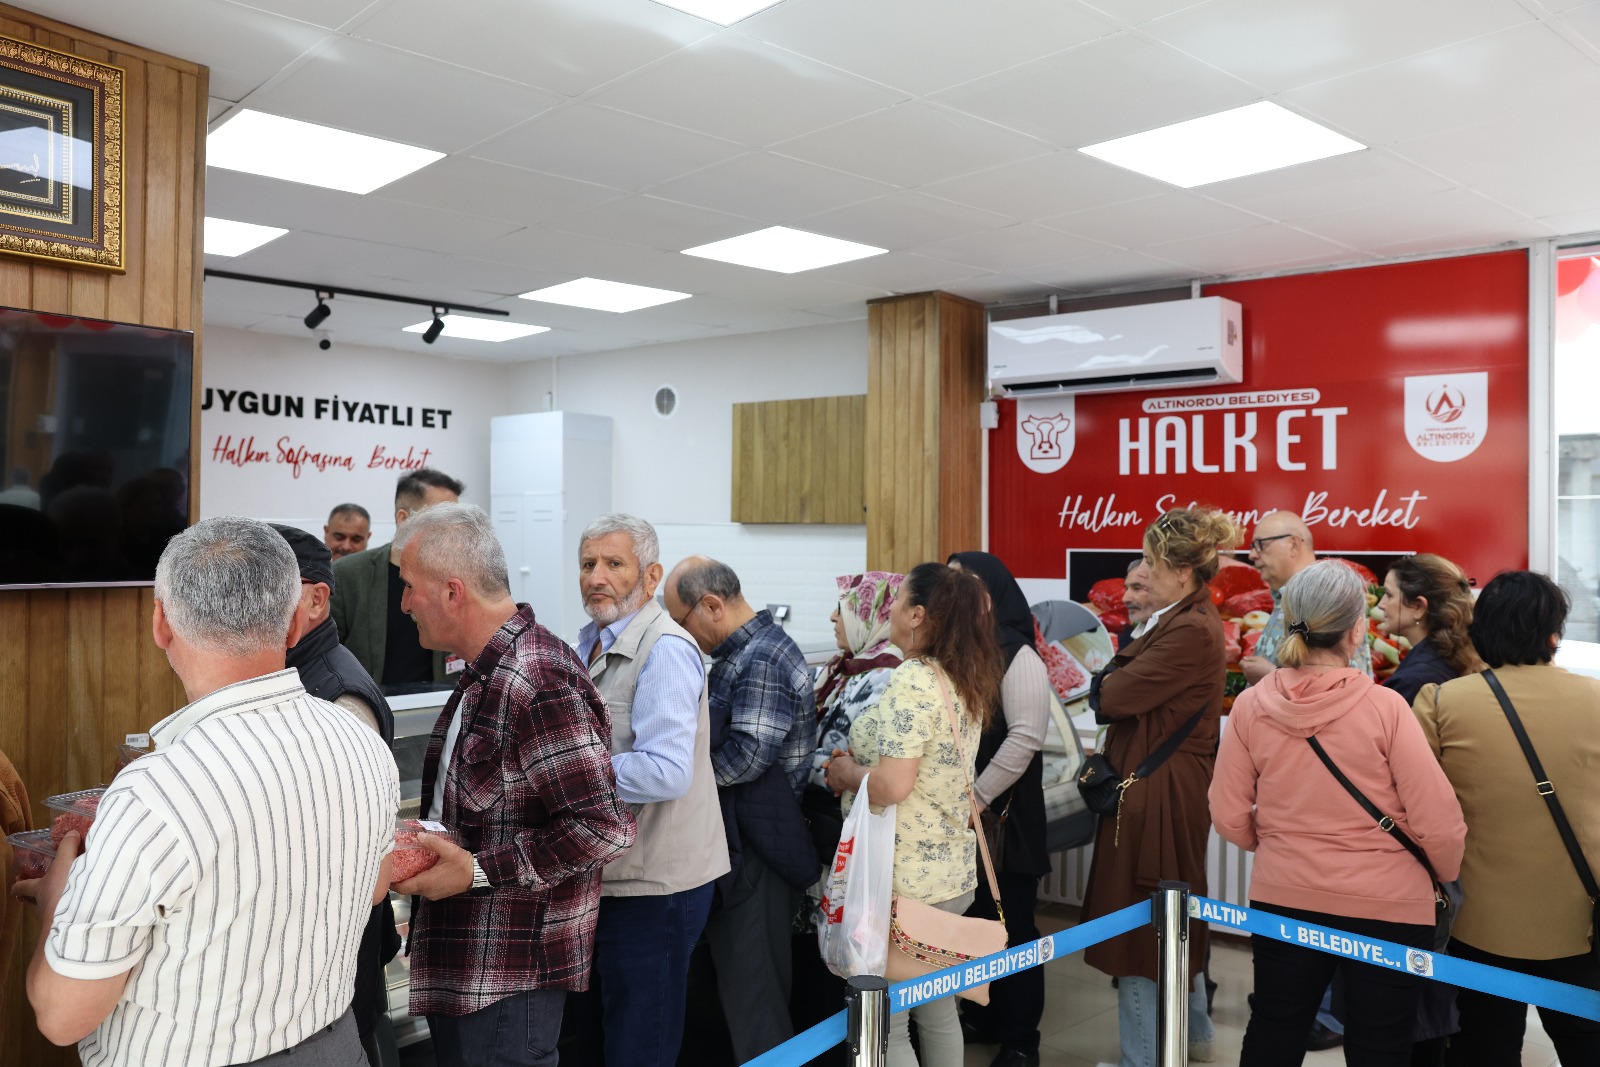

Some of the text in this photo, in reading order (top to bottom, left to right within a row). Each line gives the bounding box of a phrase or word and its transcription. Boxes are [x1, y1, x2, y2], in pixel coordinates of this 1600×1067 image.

[314, 394, 413, 427] FİYATLI
[422, 408, 452, 429] ET
[1148, 391, 1314, 411] ALTINORDU BELEDİYESİ
[212, 435, 433, 479] Halkın Sofrasına Bereket
[1118, 406, 1349, 476] HALK ET
[1416, 431, 1475, 441] ALTINORDU
[1058, 493, 1143, 533] Halkın
[1301, 488, 1428, 530] Bereket
[964, 943, 1038, 987] BELEDİYESİ
[1297, 926, 1401, 968] BELEDIYE
